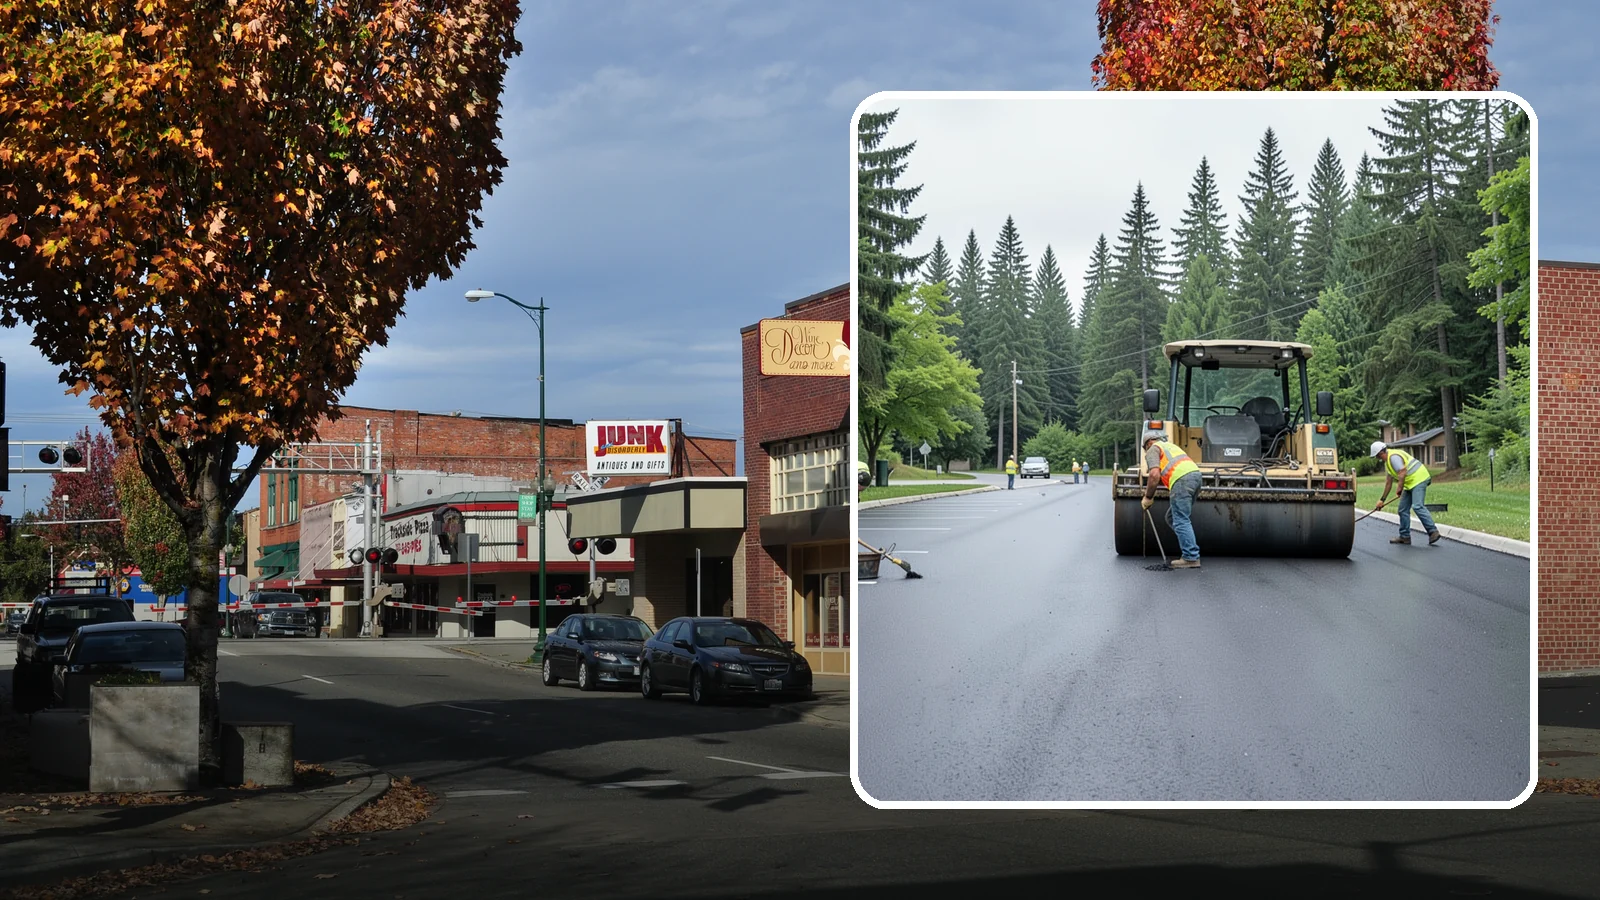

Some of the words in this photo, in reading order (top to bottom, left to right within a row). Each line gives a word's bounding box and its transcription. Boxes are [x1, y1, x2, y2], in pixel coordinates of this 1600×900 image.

[595, 425, 666, 457] JUNK
[607, 446, 646, 454] DISORDERLY
[597, 461, 628, 470] ANTIQUES
[631, 461, 644, 470] AND
[647, 460, 666, 469] GIFTS
[414, 519, 429, 535] Pizza
